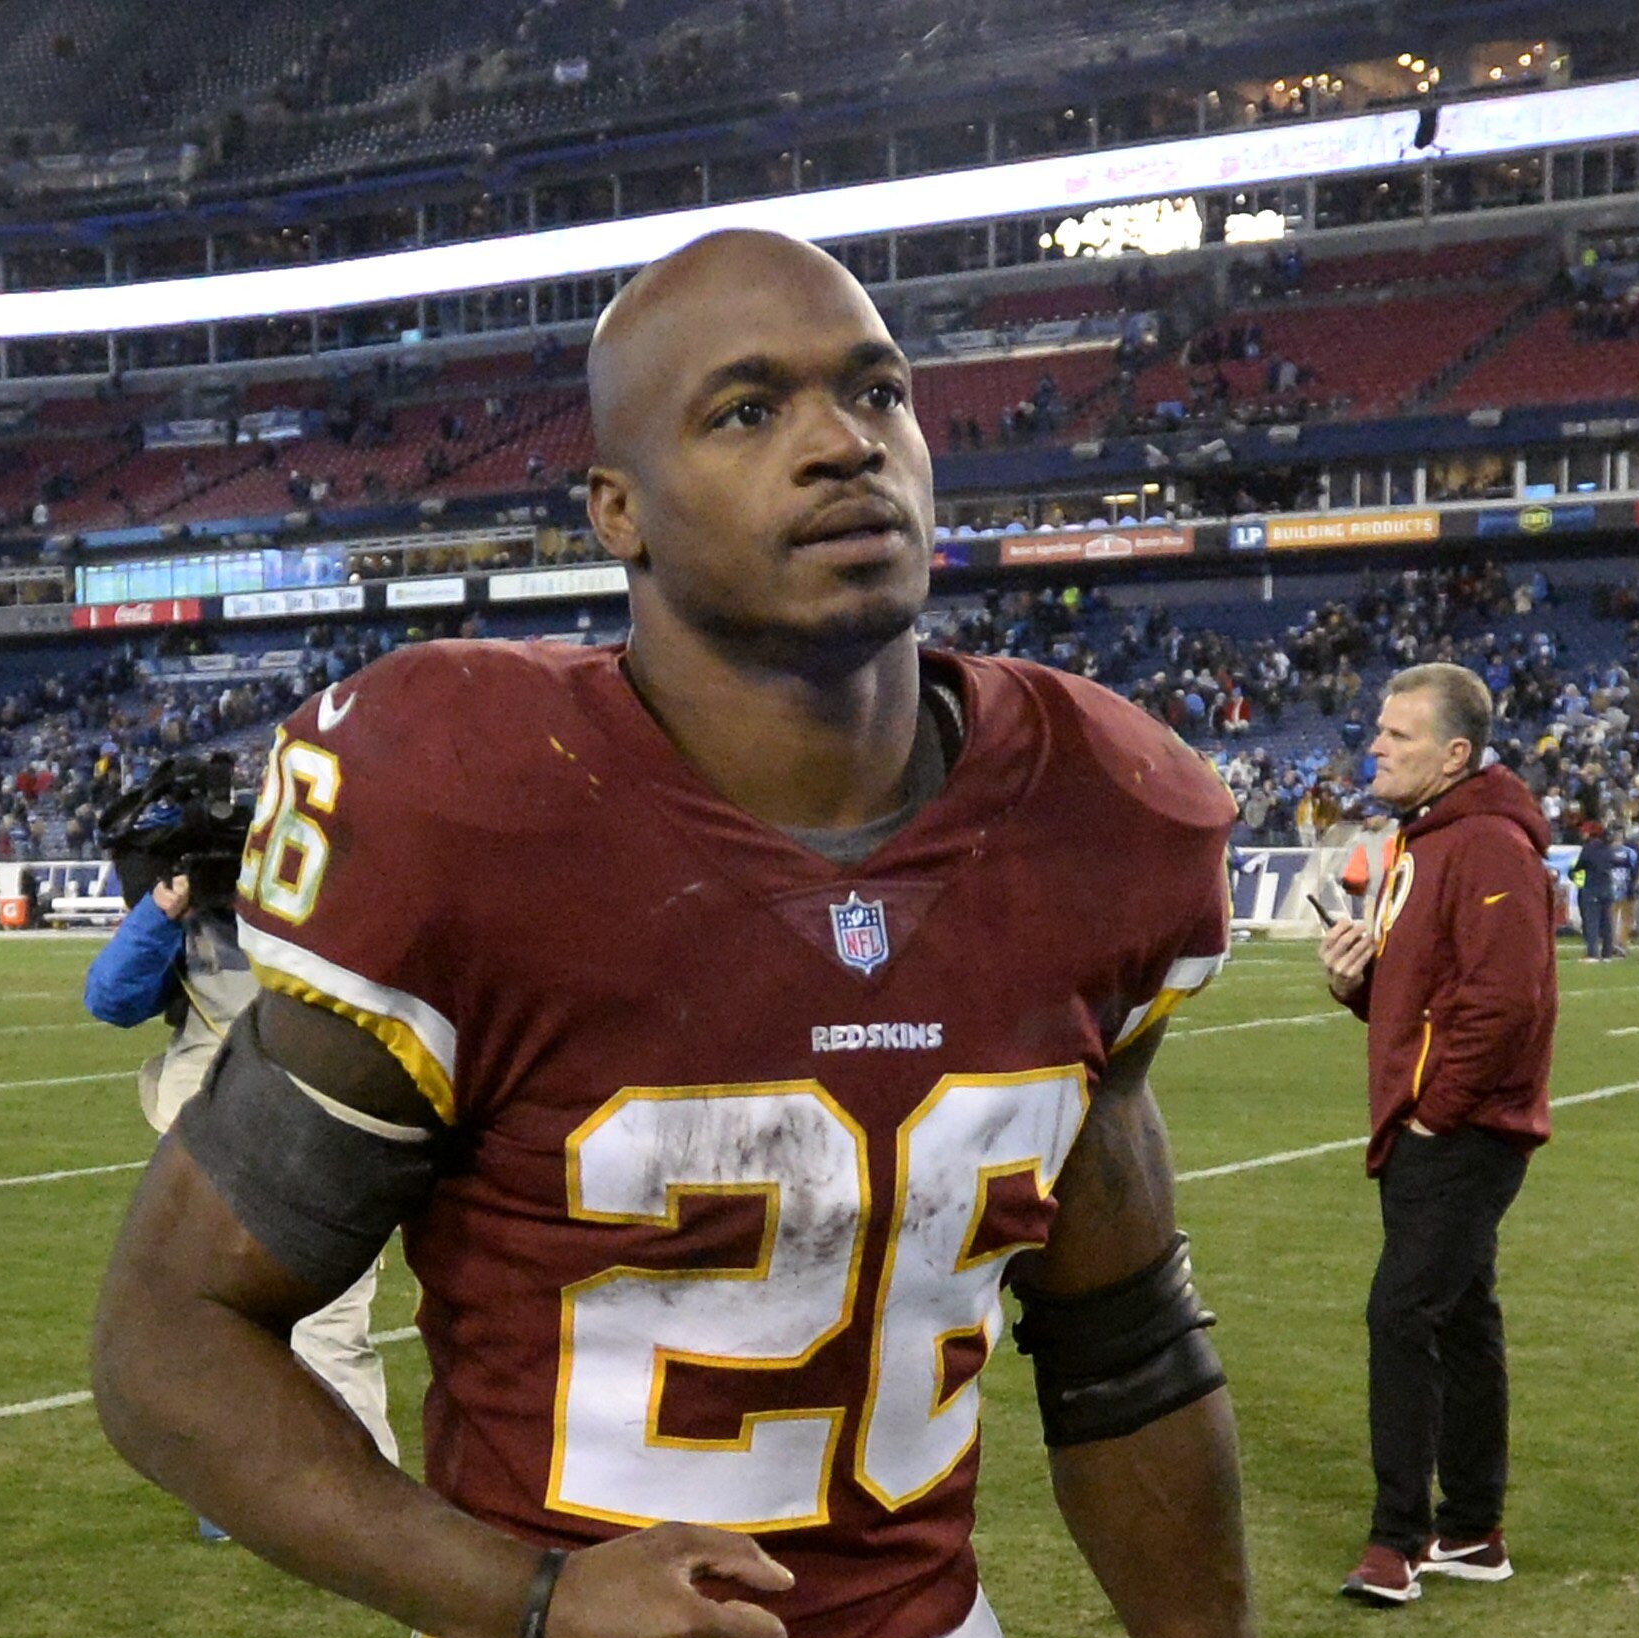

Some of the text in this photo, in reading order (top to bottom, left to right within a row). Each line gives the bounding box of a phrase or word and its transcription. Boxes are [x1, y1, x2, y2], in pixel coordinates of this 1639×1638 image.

[1236, 517, 1434, 544] LP BUILDING PRODUCTS
[844, 928, 881, 958] NFL
[812, 1022, 943, 1051] REDSKINS
[544, 1062, 1090, 1532] 26
